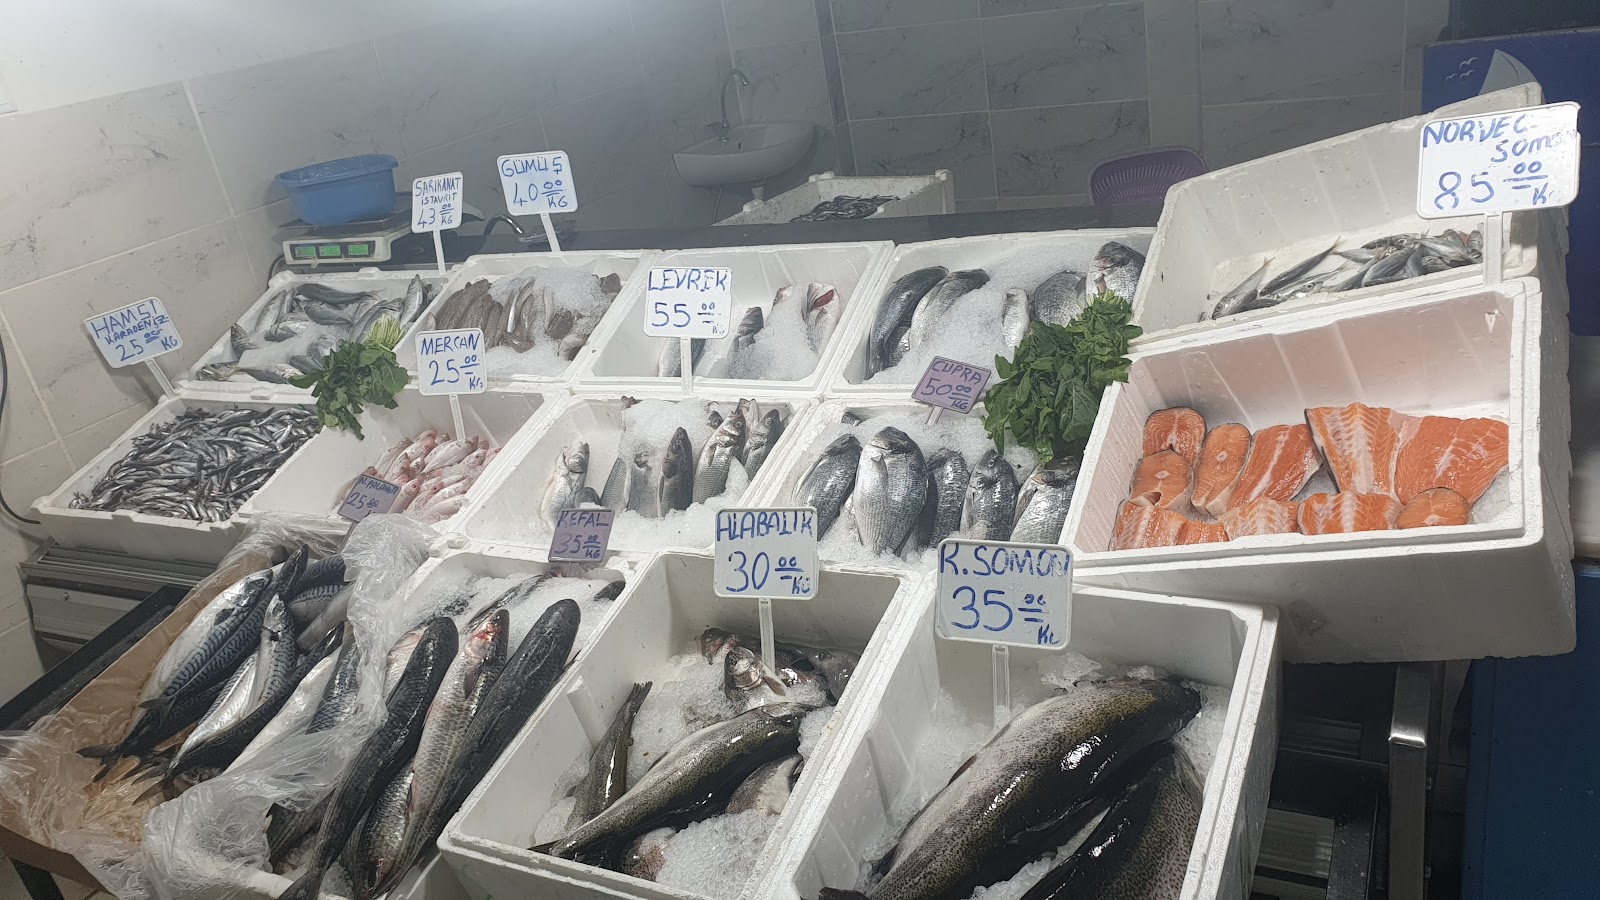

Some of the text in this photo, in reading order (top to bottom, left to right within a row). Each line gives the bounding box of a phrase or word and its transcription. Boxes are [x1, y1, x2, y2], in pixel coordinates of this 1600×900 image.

[513, 180, 562, 207] 40 00
[1434, 161, 1542, 210] 85 00
[548, 195, 568, 209] KG
[416, 208, 436, 229] 43
[441, 215, 452, 226] KG
[651, 301, 715, 327] 55 00
[115, 339, 144, 361] 25
[160, 336, 178, 350] KG
[421, 333, 480, 355] MERCAN
[429, 355, 477, 385] 25 00
[921, 377, 972, 395] 50 00
[951, 400, 968, 410] KG
[346, 492, 367, 509] 25
[557, 511, 609, 527] KEFAL
[554, 533, 582, 554] 35
[585, 548, 600, 559] KG
[726, 551, 770, 592] 30
[951, 586, 1013, 632] 35
